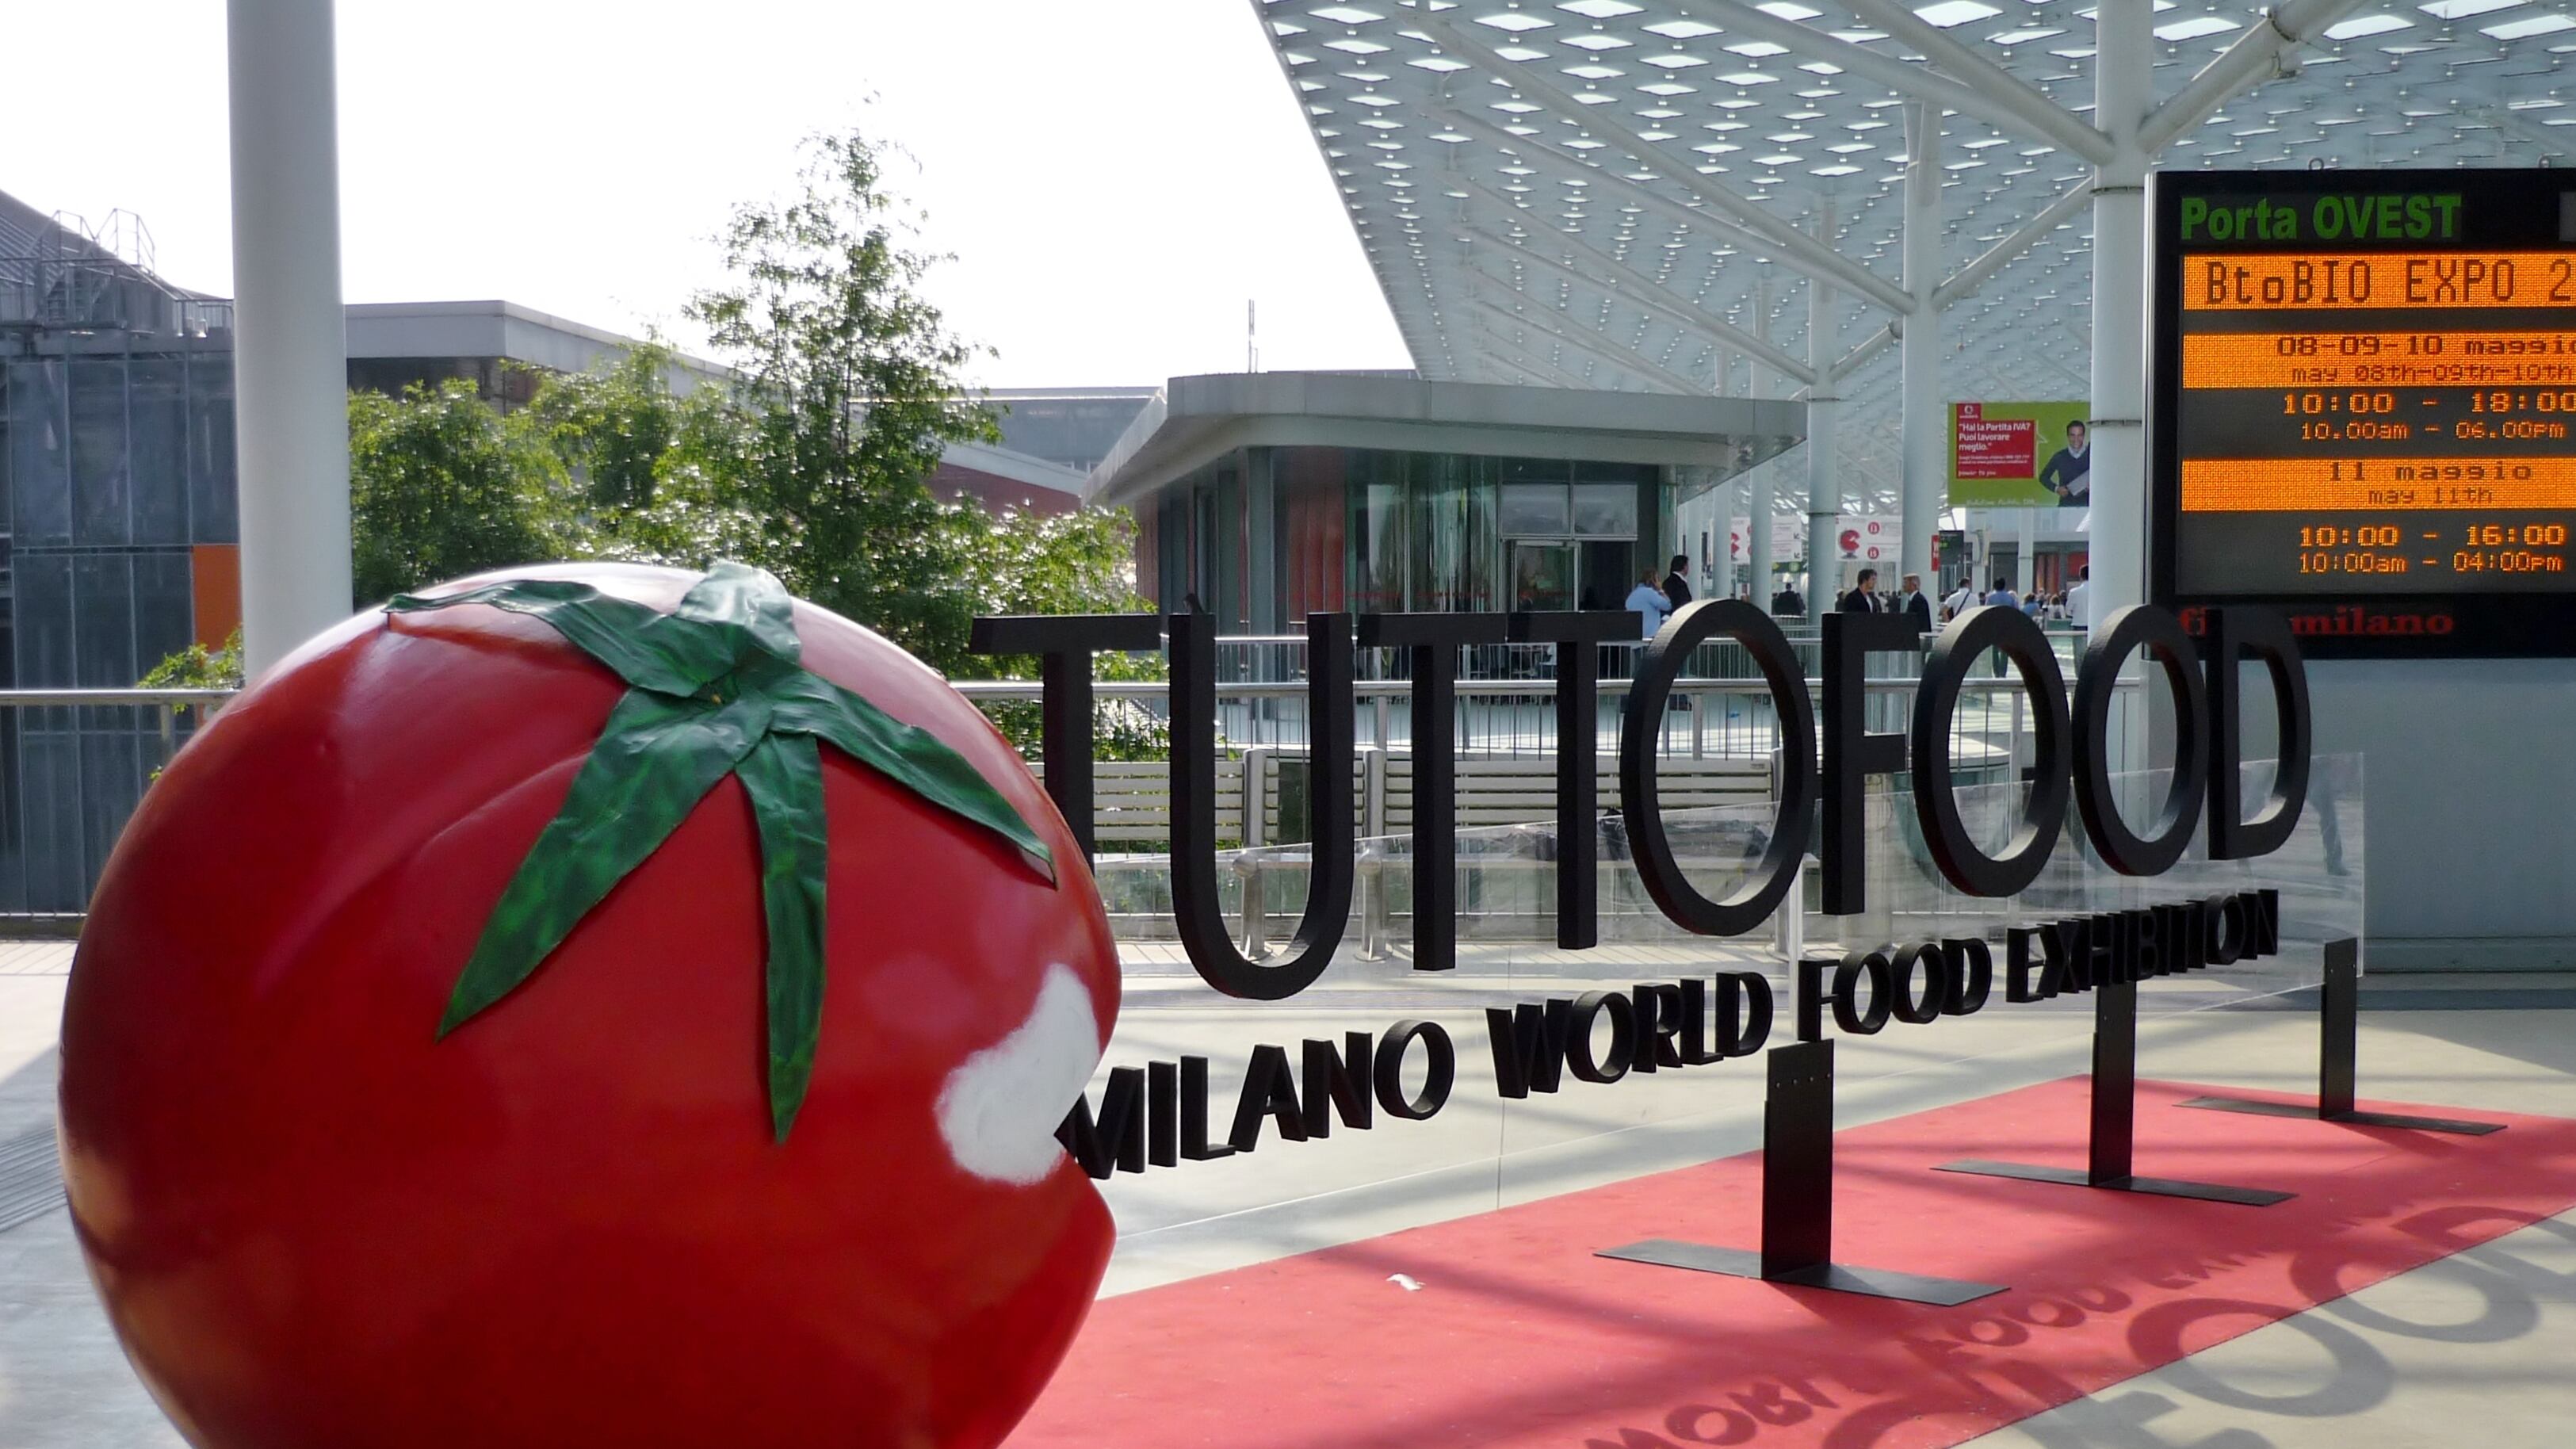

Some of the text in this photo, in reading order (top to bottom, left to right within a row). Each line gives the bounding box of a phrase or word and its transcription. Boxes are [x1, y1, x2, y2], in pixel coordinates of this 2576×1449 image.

[2181, 194, 2461, 239] Porta OVEST
[2204, 260, 2371, 304] BtoBIO
[2405, 258, 2515, 302] EXPO
[2278, 334, 2443, 356] 08-09-10
[2292, 363, 2573, 383] may 08th-09th-10th
[2284, 392, 2395, 415] 10:00
[2471, 392, 2576, 413] 18:00
[2302, 422, 2410, 439] 10.00am
[2456, 422, 2566, 438] 06.00pm
[2330, 461, 2532, 481] 11 maggio
[2368, 487, 2494, 505] may 11th
[2299, 526, 2400, 547] 10:00
[2466, 525, 2566, 546] 16:00
[2299, 552, 2409, 573] 10:00am
[2453, 551, 2565, 572] 04:00pm
[2289, 606, 2454, 637] milano
[971, 598, 2311, 1000] TUTTOFOOD
[1053, 889, 2279, 1179] MILANO WORLD FOOD EXHIBITION
